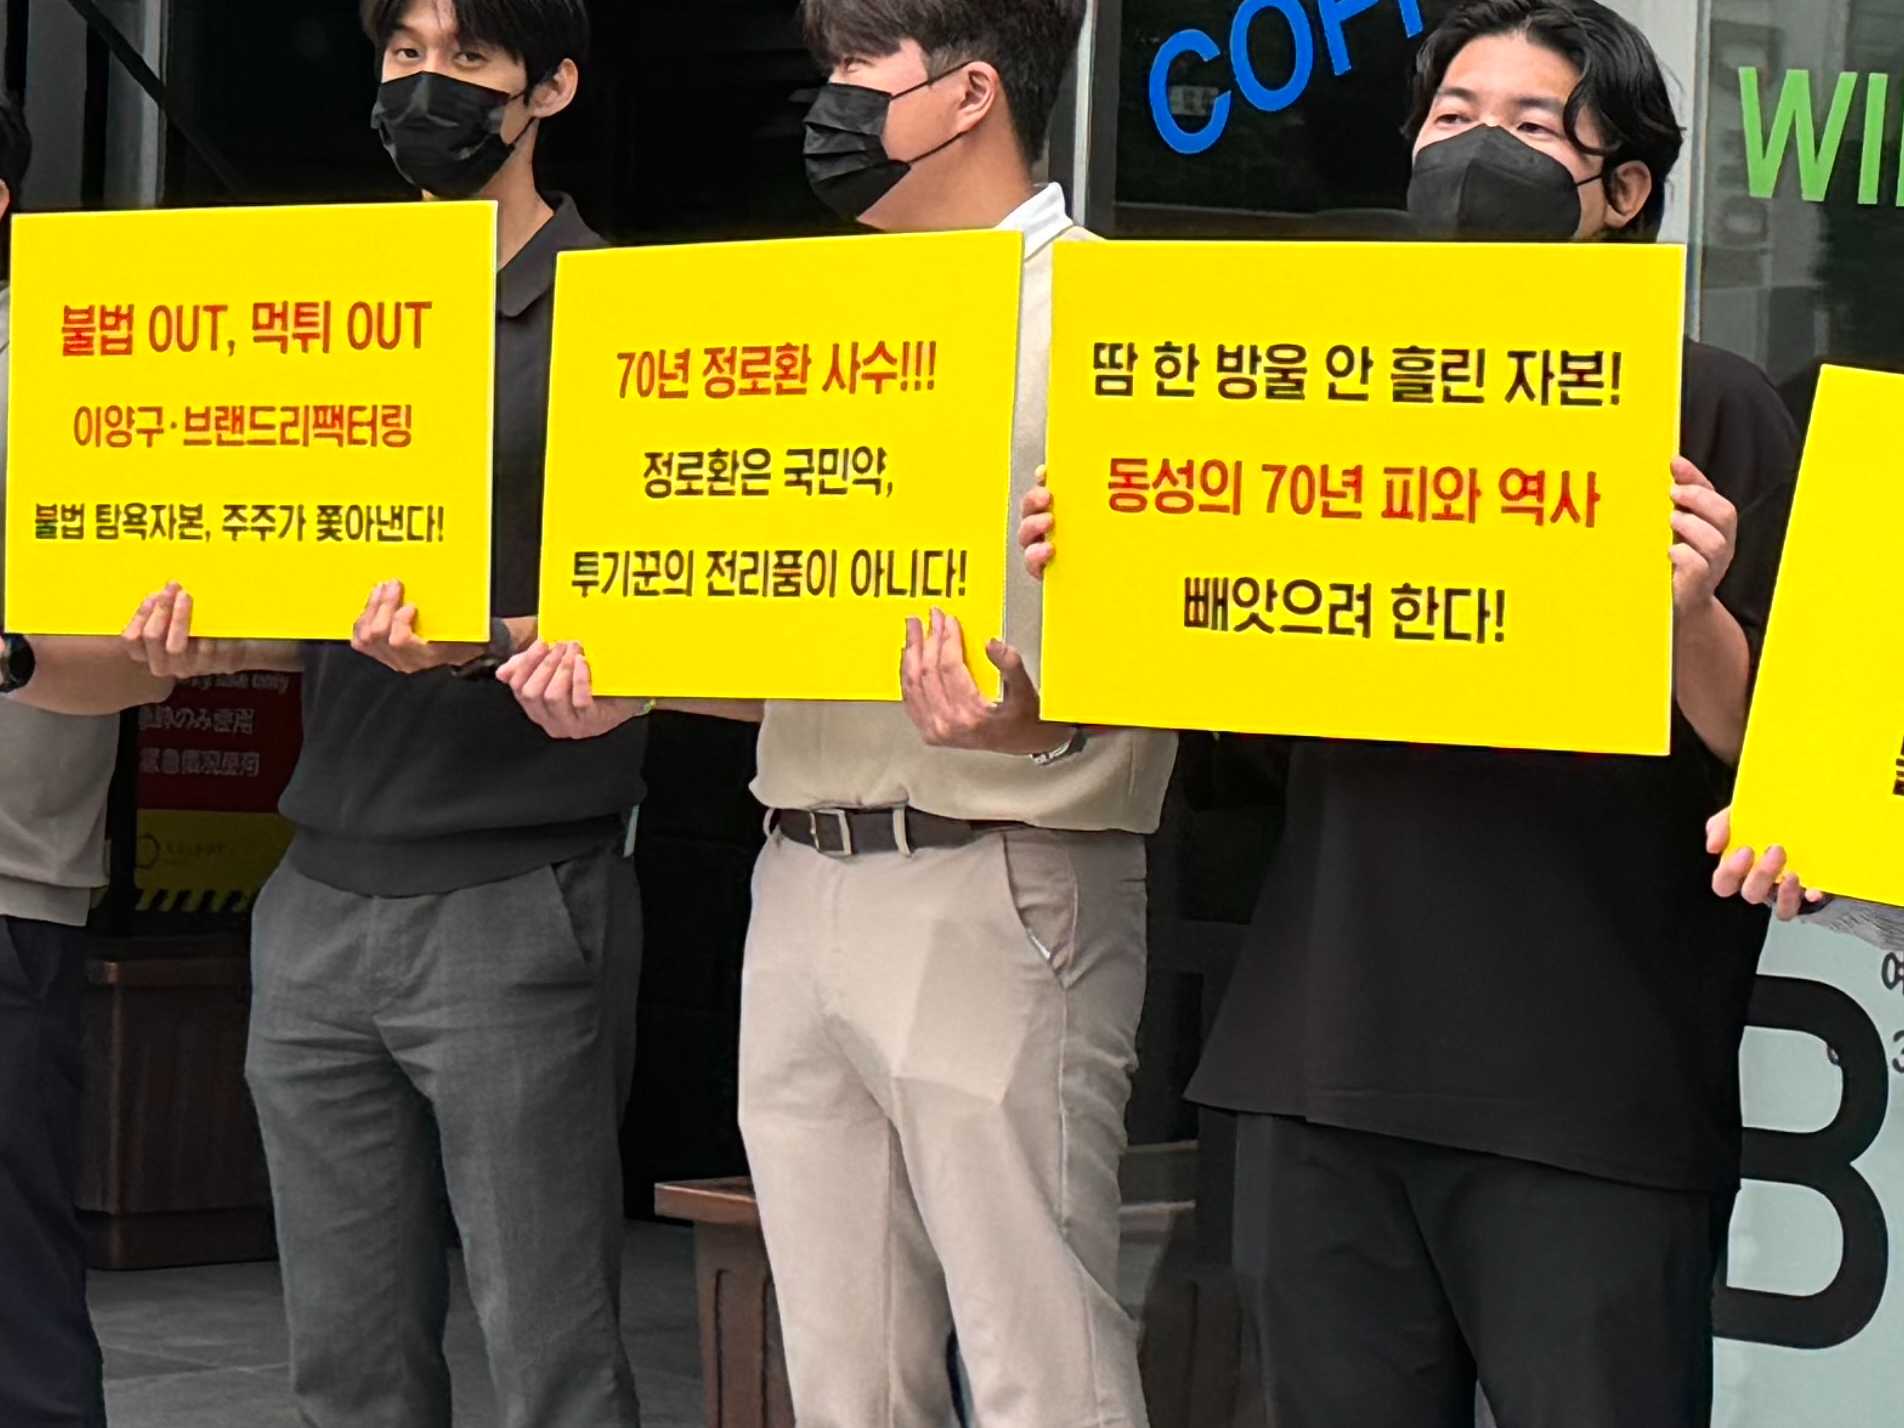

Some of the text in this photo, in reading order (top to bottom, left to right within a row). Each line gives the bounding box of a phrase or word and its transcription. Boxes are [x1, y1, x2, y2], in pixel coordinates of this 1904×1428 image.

[60, 300, 433, 357] 불법 OUT, 먹튀 OUT
[616, 340, 937, 399] 70년 정로환 사수!!!
[1092, 341, 1623, 408] 땀 한 방울 안 흘린 자본!
[643, 445, 893, 499] 정로환은 국민약,
[1106, 456, 1602, 529] 동성의 70년 피와 역사
[34, 502, 445, 544] 불법 탐욕자본, 주주가 쫓아낸다!
[571, 548, 968, 598] 투기꾼의 전리품이 아니다!
[1182, 575, 1507, 644] 빼앗으려 한다!
